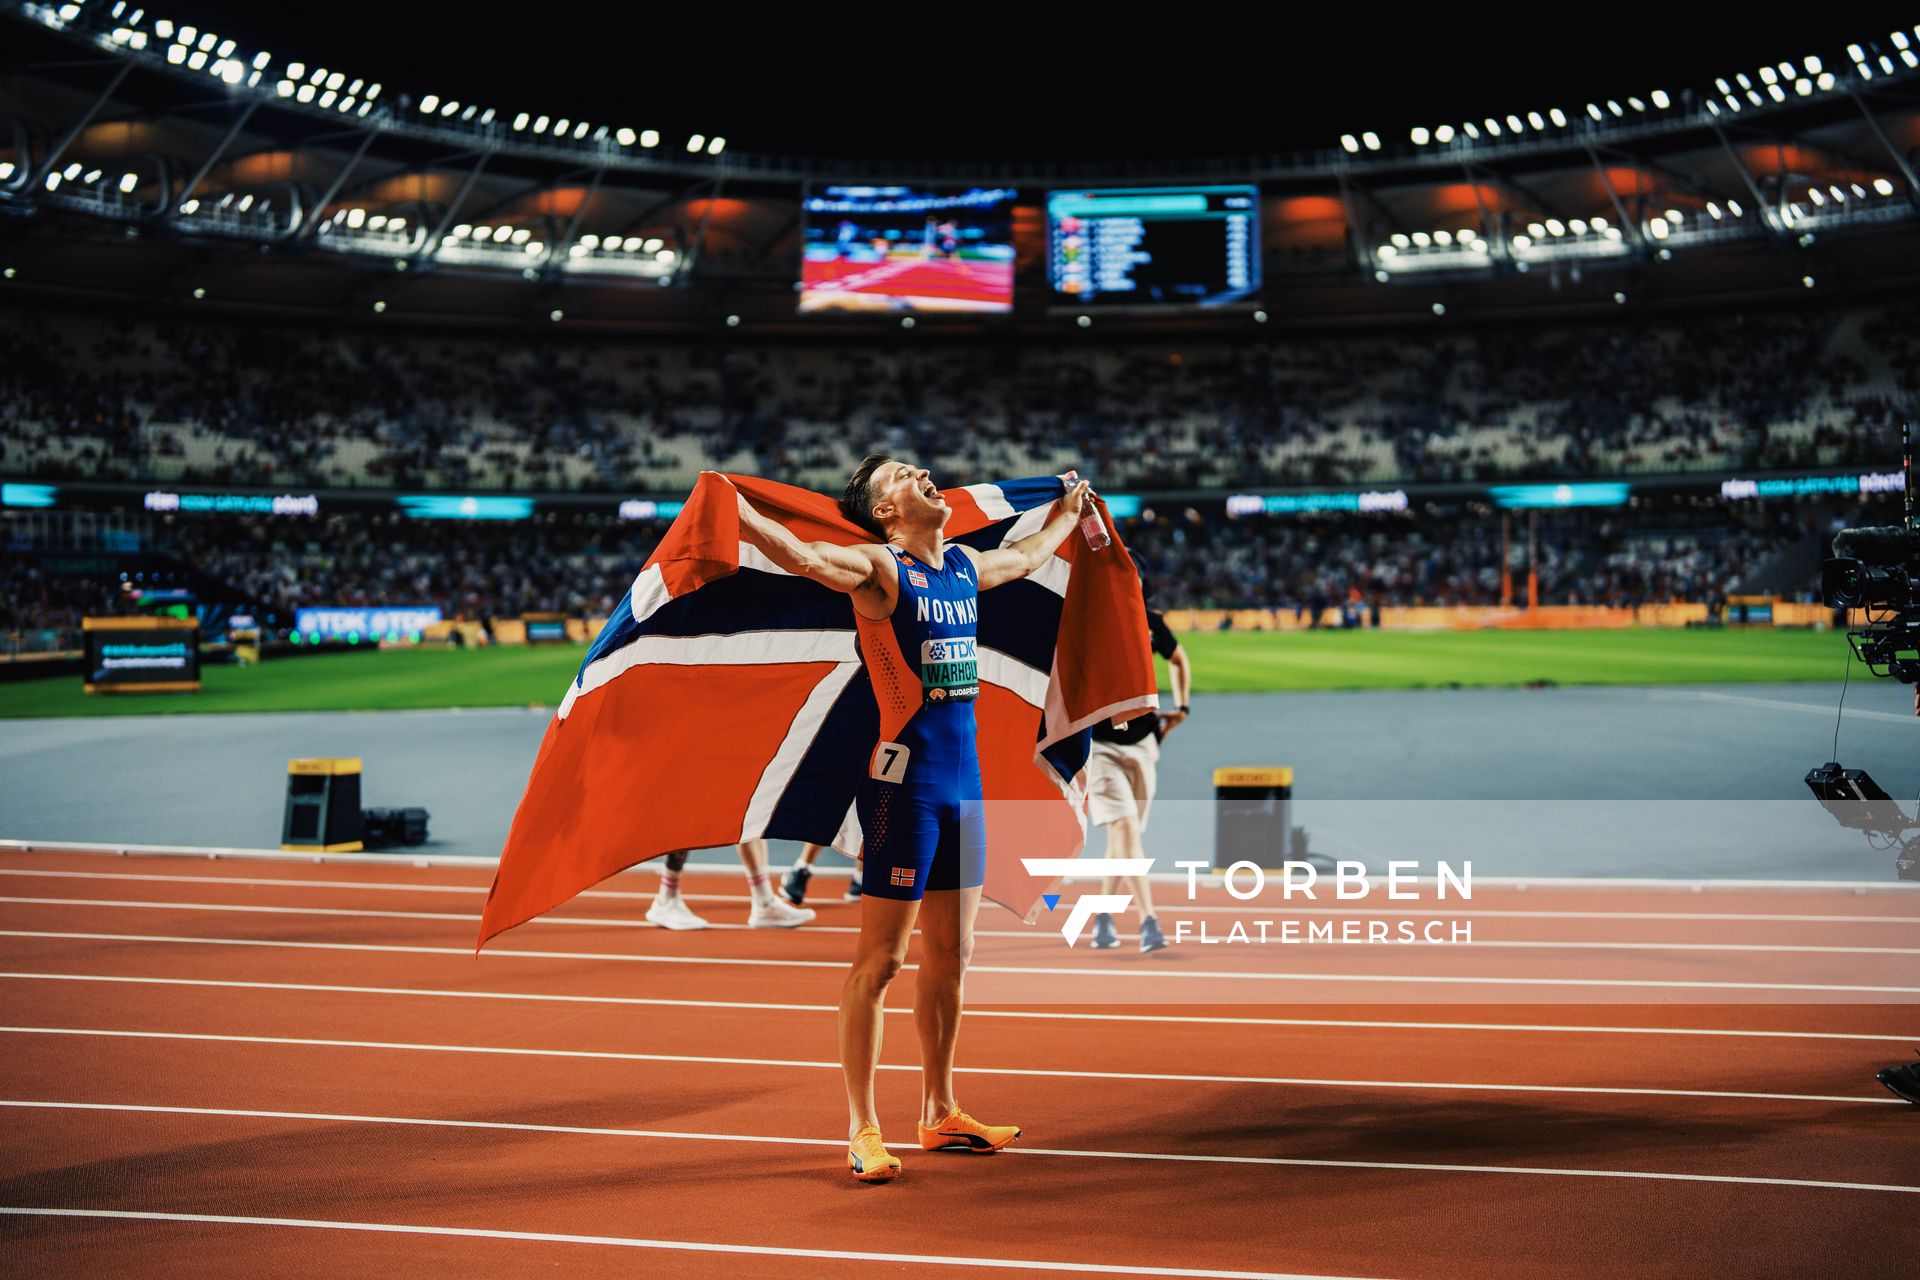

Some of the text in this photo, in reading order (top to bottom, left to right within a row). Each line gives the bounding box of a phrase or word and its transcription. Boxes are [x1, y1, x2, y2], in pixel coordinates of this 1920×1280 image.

[945, 640, 976, 659] TDK
[926, 660, 977, 683] WARHOL
[881, 748, 900, 776] 7
